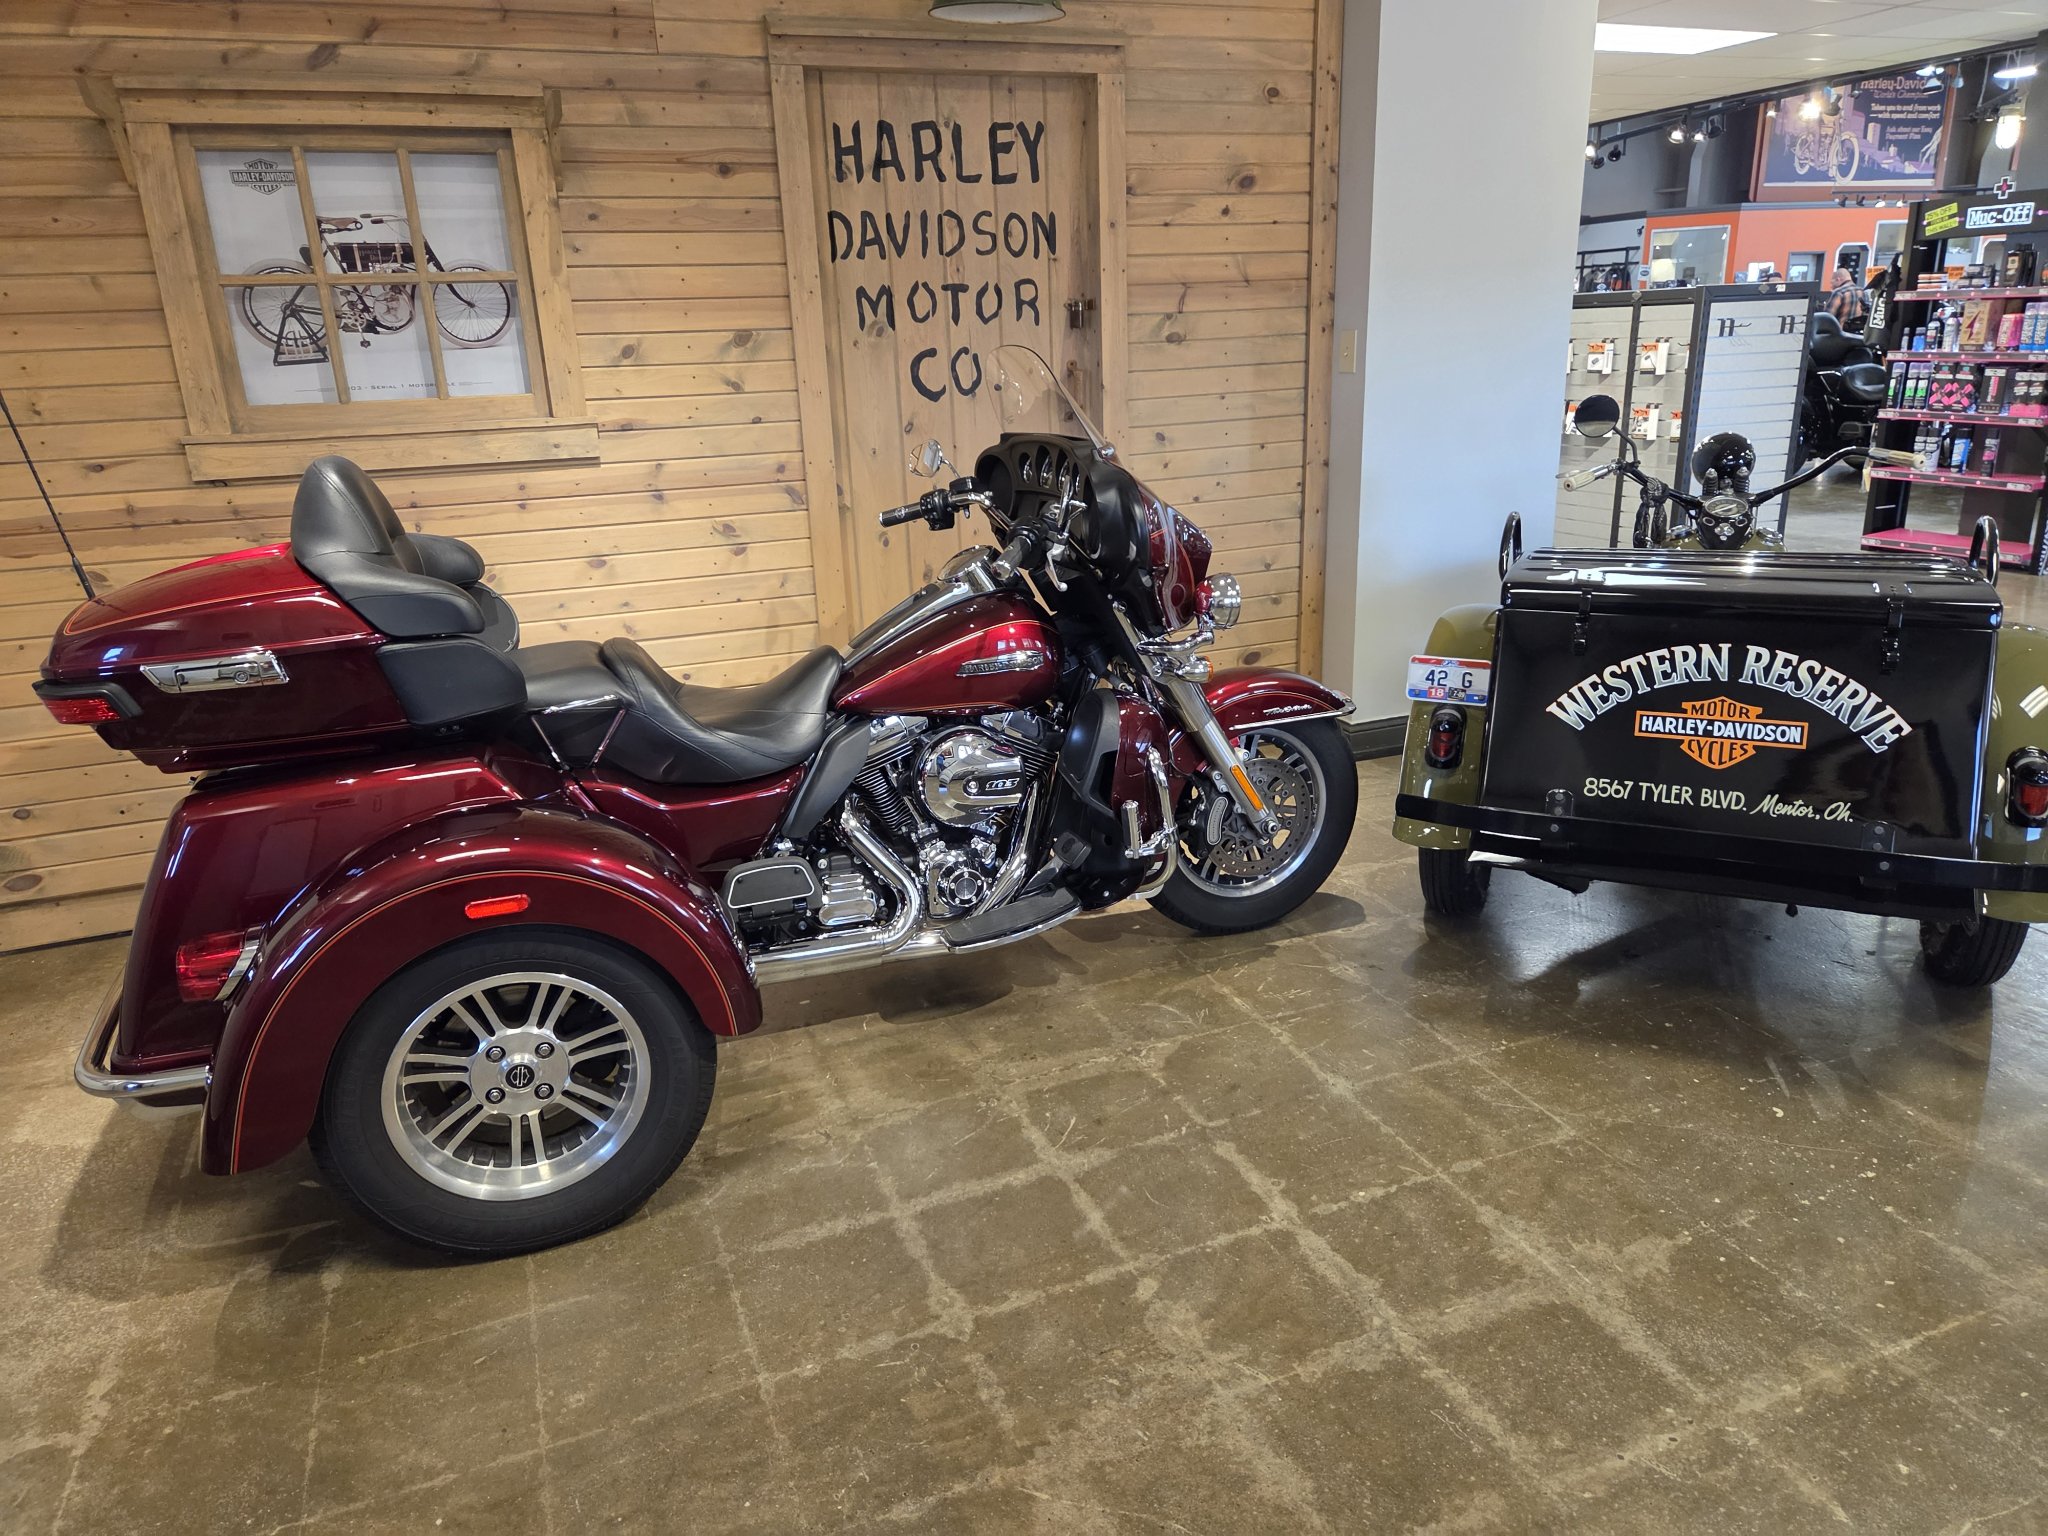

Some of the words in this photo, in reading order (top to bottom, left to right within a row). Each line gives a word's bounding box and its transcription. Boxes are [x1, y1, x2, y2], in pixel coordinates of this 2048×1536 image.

[1860, 76, 1928, 90] Harley-David
[832, 119, 1045, 185] HARLEY
[248, 160, 274, 169] MOTOR
[233, 172, 294, 182] HARLEY-DAVIDSON
[253, 184, 279, 193] CYCLES
[1969, 205, 2031, 225] Muc-Off
[828, 209, 1057, 263] DAVIDSON
[855, 278, 1040, 331] MOTOR
[1425, 669, 1448, 687] 42
[1462, 671, 1473, 688] G
[1430, 688, 1444, 697] 18
[1545, 643, 1733, 731] WESTERN
[1738, 644, 1913, 754] RESERVE
[1690, 698, 1751, 719] MOTOR
[1641, 715, 1802, 744] HARLEY-DAVIDSON
[1687, 739, 1750, 766] CYCLES
[1583, 777, 1634, 800] 8567
[1638, 782, 1694, 806] TYLER
[1700, 788, 1747, 811] BLVD.
[1749, 793, 1820, 820] Mentor,
[1824, 801, 1854, 823] Oh.
